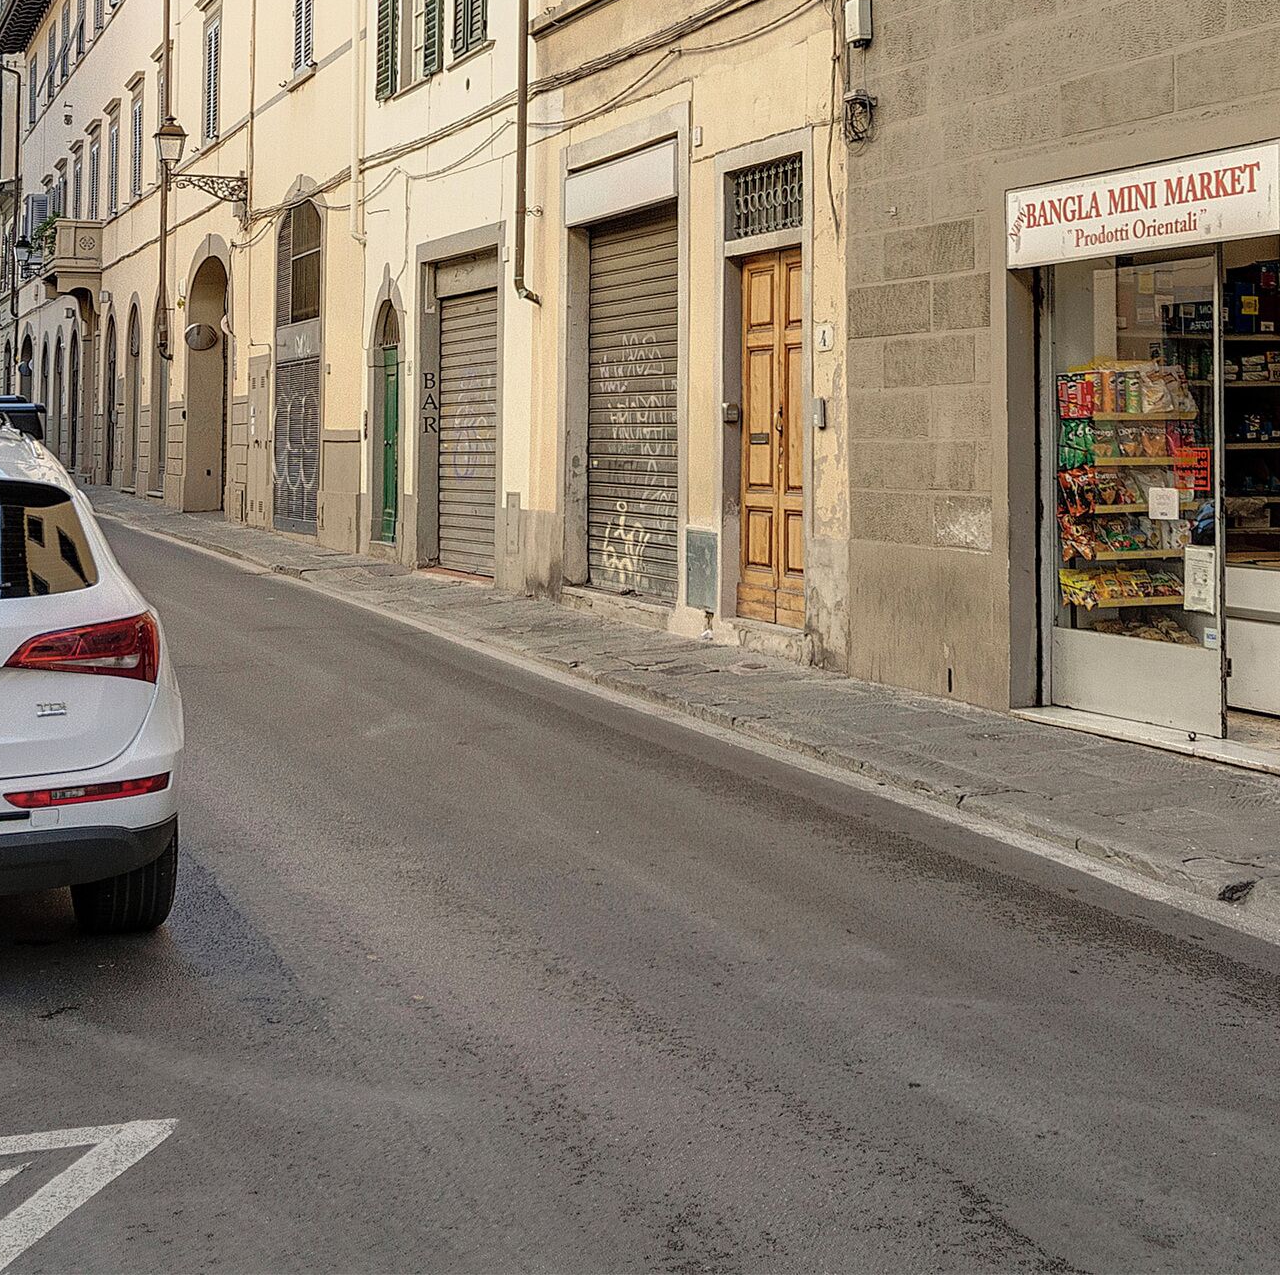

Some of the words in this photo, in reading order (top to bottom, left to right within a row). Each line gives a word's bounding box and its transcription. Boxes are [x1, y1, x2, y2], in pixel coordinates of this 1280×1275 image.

[1008, 206, 1028, 243] NEW
[1025, 190, 1102, 229] BANGLA
[1107, 180, 1158, 216] MINI
[1163, 160, 1261, 207] MARKET
[422, 372, 438, 434] BAR
